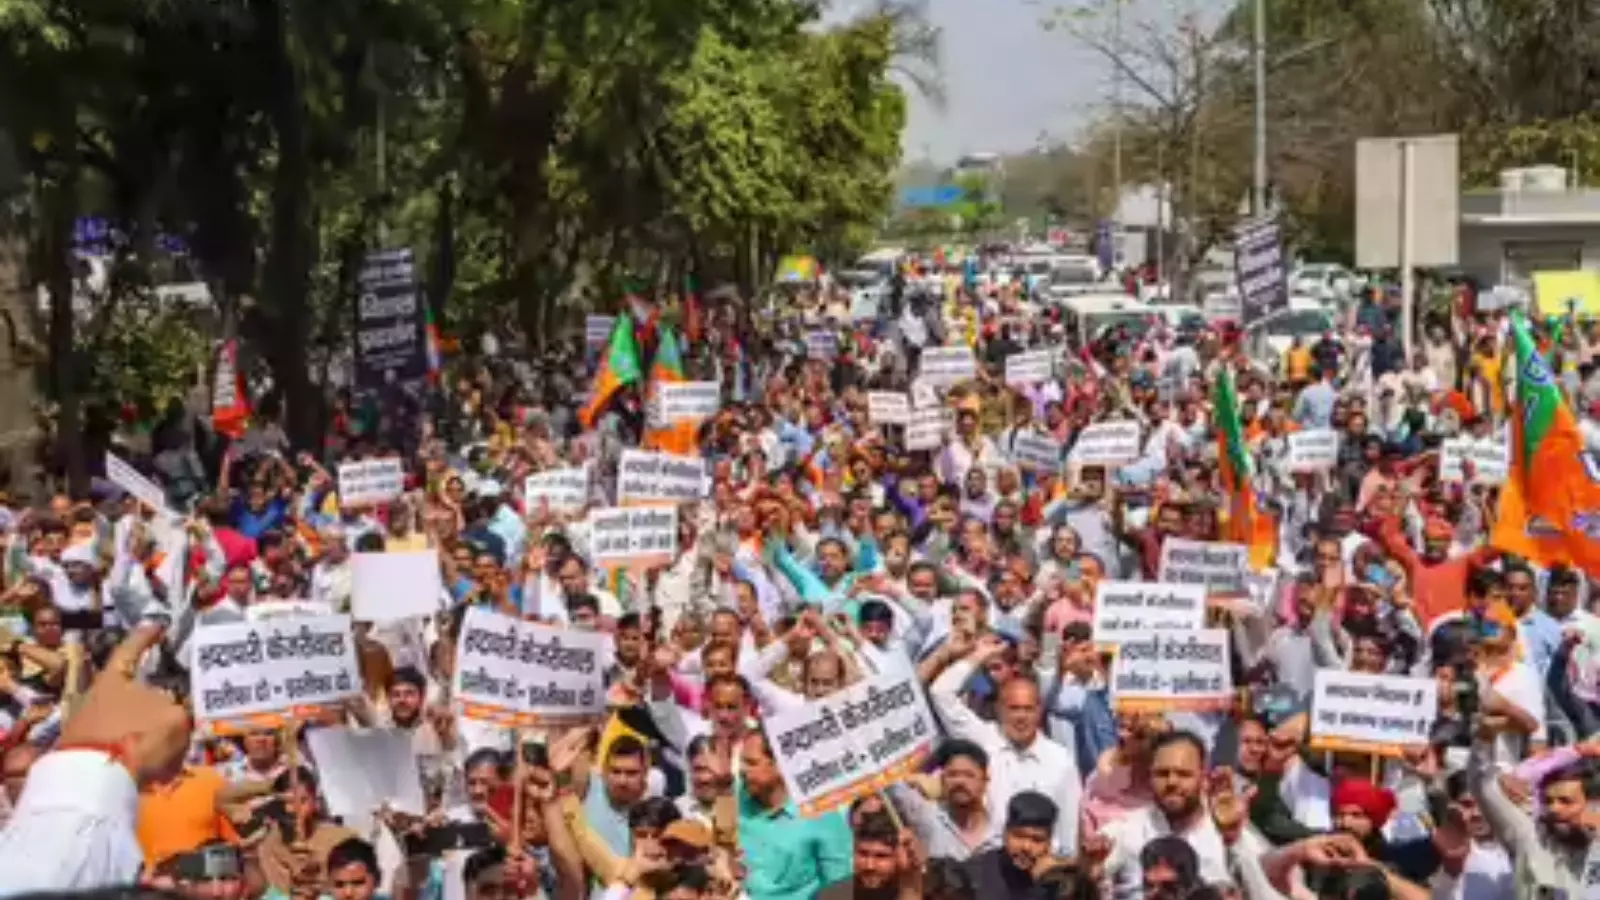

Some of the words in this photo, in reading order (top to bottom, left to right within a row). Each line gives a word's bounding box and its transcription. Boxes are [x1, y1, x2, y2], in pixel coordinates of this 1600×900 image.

[267, 625, 344, 659] केजरीवाल
[519, 634, 594, 674] केजरीवाल
[839, 679, 914, 729] केजरीवाल
